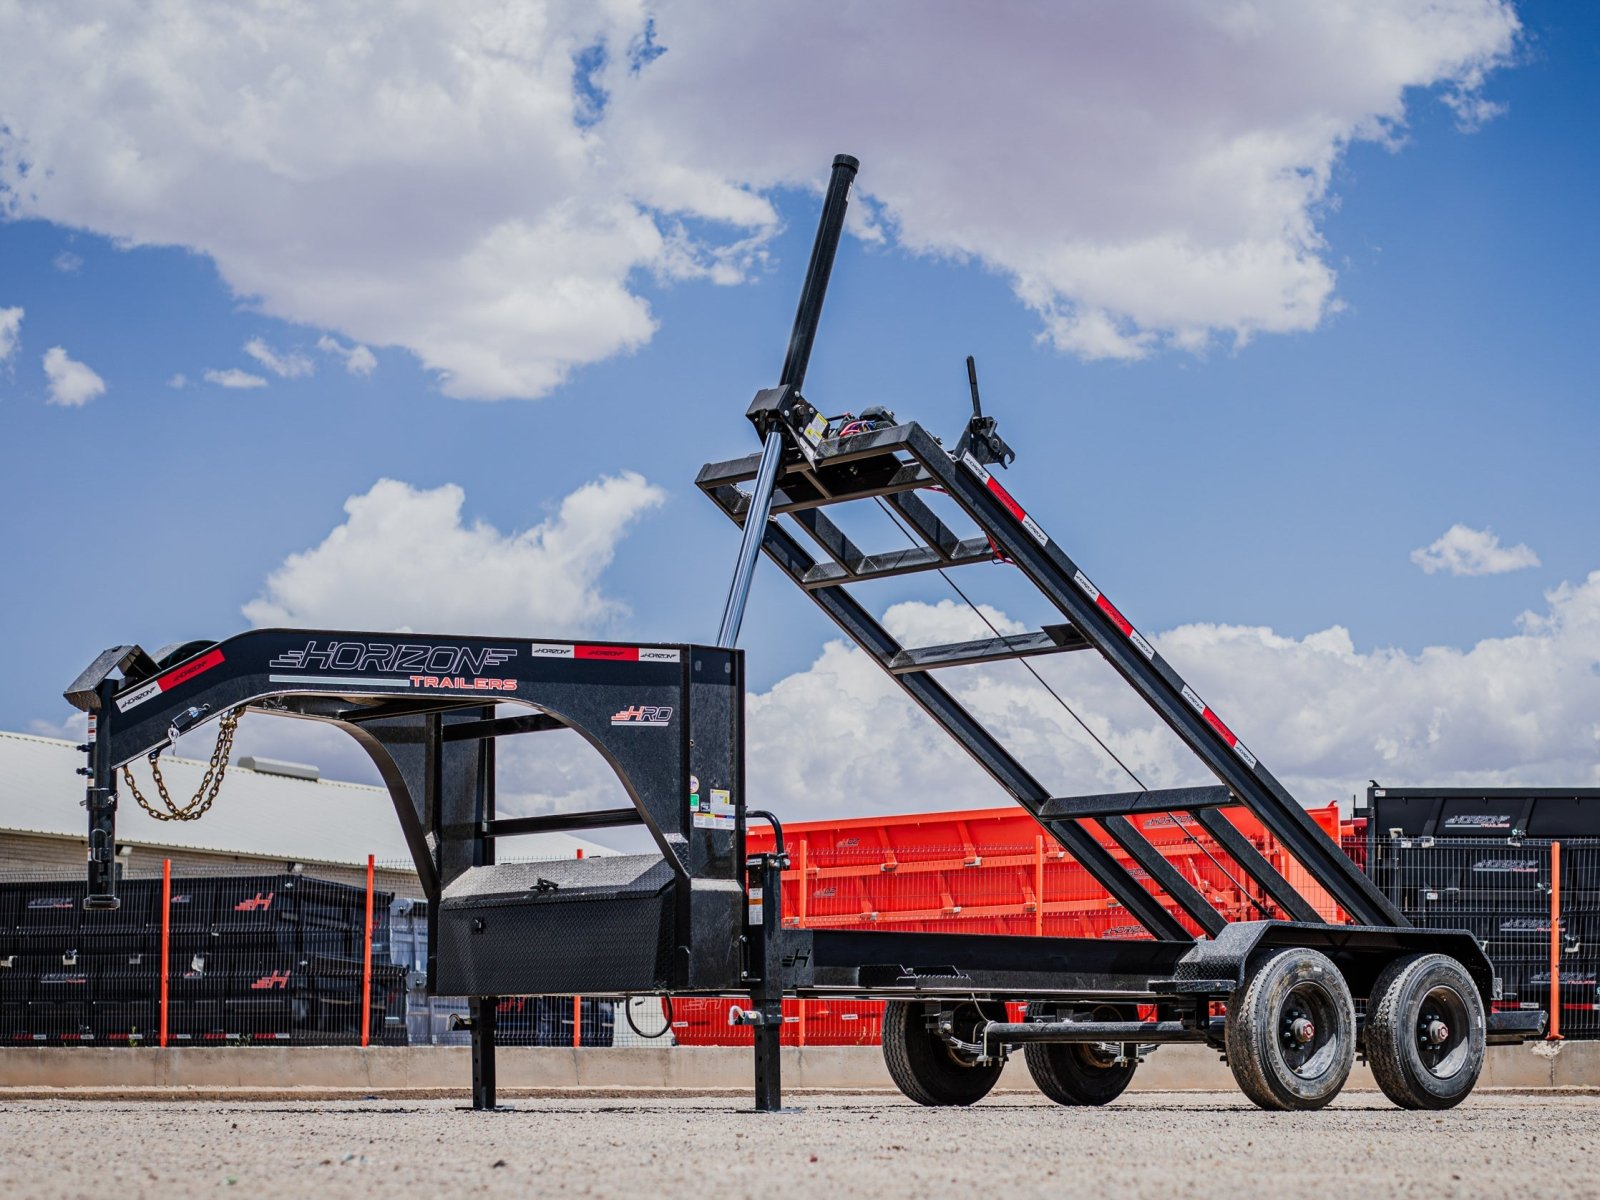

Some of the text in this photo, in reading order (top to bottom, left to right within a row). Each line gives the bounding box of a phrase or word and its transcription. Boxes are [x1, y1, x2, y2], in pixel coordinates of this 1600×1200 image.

[292, 640, 496, 675] HORIZON
[535, 647, 570, 655] HORIZON
[410, 676, 518, 691] TRAILERS
[121, 687, 156, 709] HORIZON
[621, 705, 673, 721] HRD
